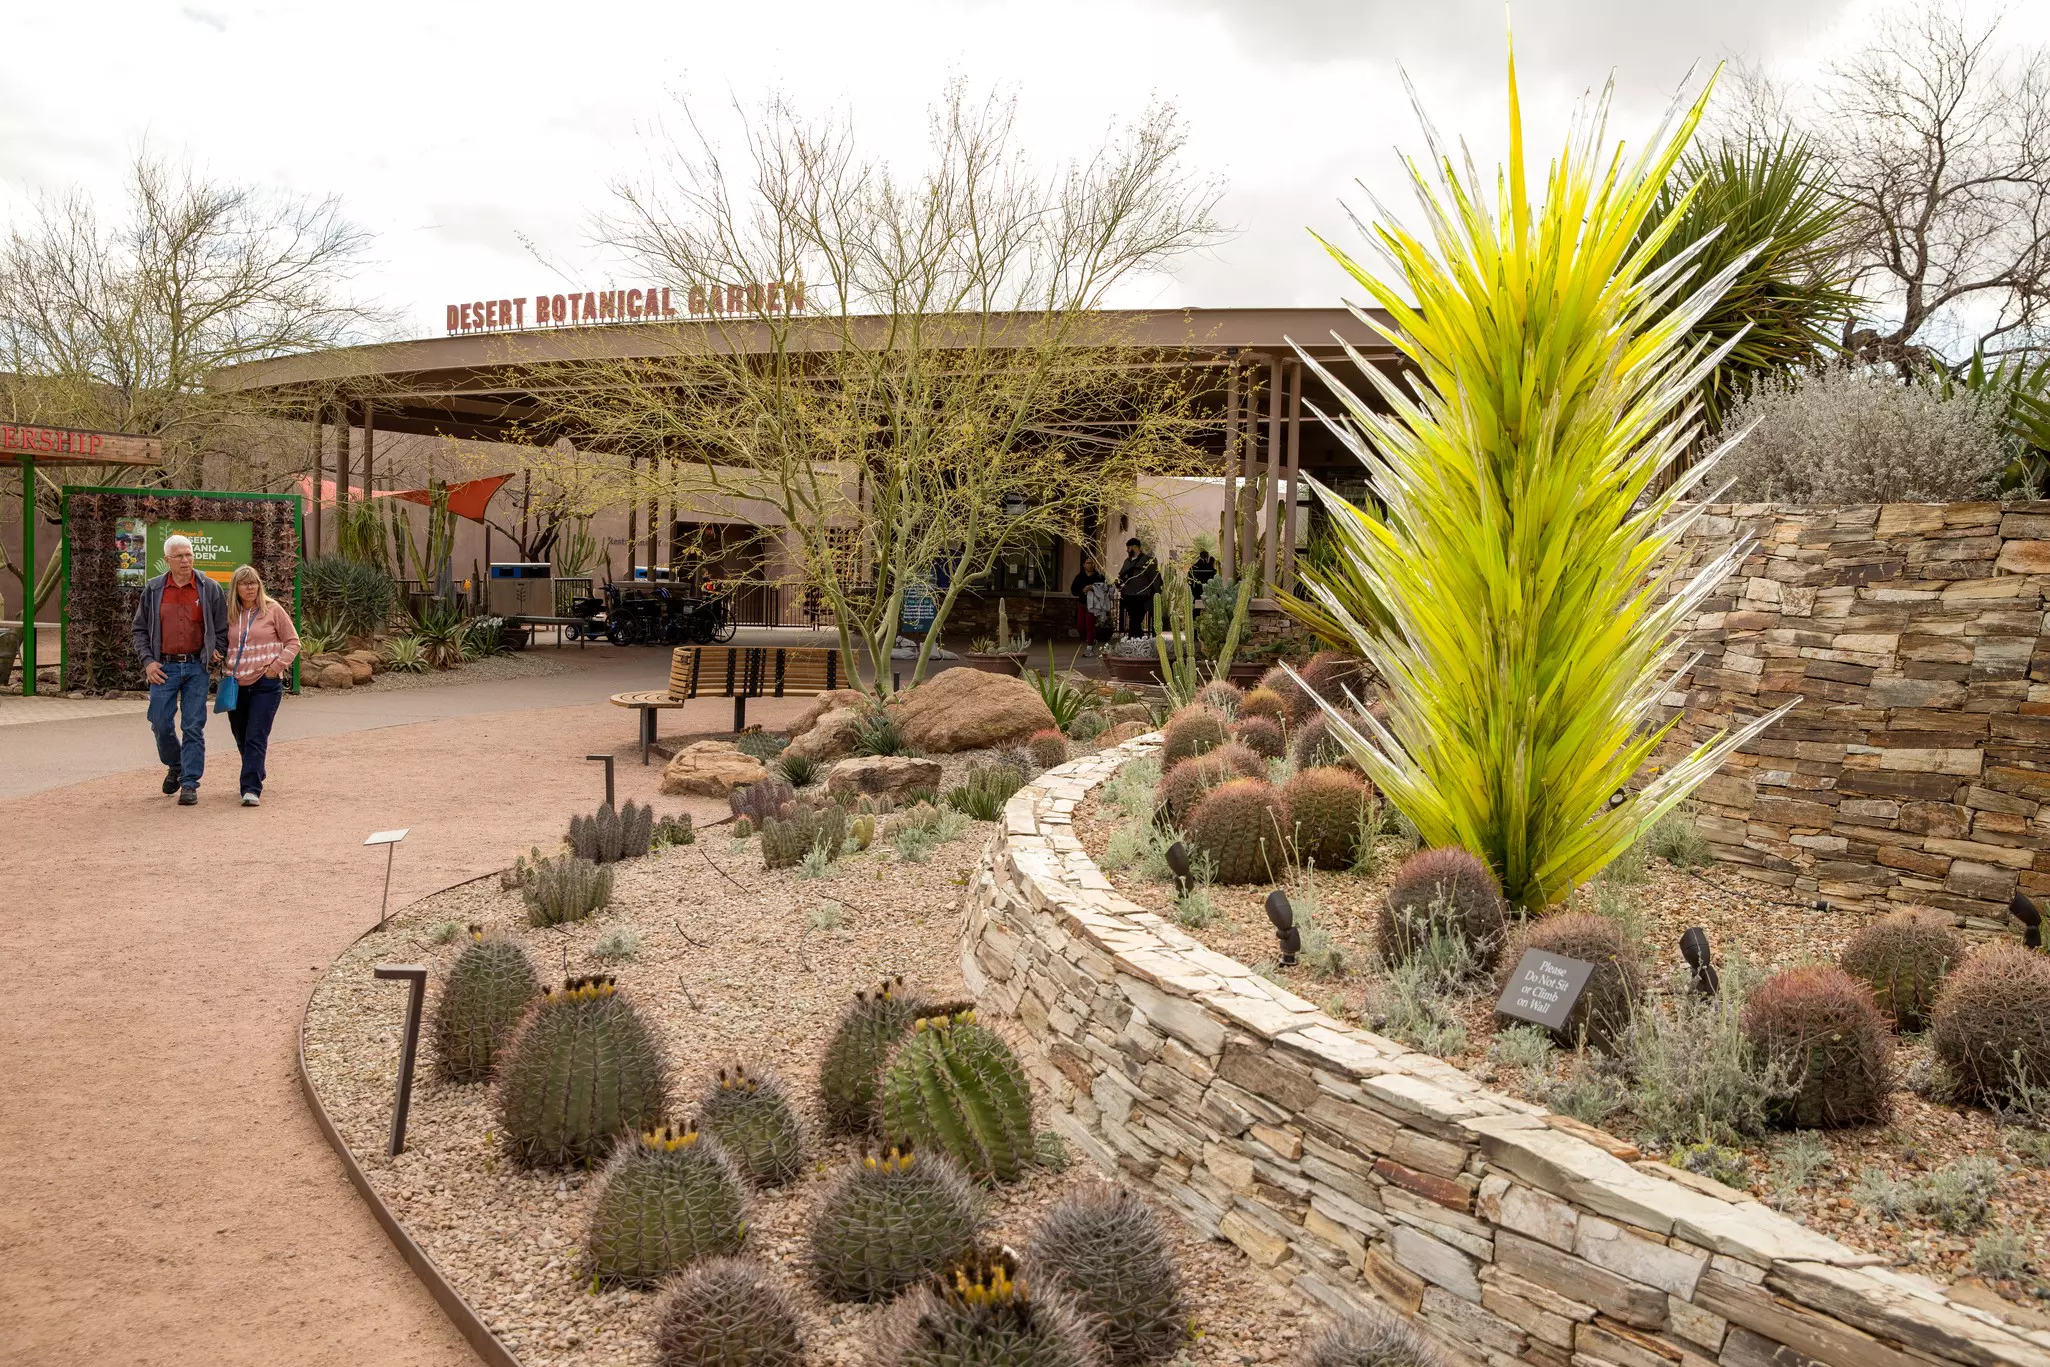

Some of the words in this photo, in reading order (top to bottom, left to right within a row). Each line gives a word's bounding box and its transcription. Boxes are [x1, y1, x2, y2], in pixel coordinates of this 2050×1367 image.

[447, 298, 527, 331] DESERT
[536, 287, 676, 323] BOTANICAL
[688, 281, 806, 314] GARDEN
[3, 427, 103, 455] ERSHIP
[187, 536, 213, 544] SERT
[194, 552, 216, 560] DEN
[1540, 960, 1567, 977] Please
[1525, 970, 1538, 982] Do
[1538, 974, 1557, 988] Not
[1555, 980, 1569, 992] Sit
[1521, 985, 1532, 994] or
[1532, 986, 1559, 1002] Climb
[1516, 998, 1529, 1008] on
[1530, 999, 1551, 1014] Wall
